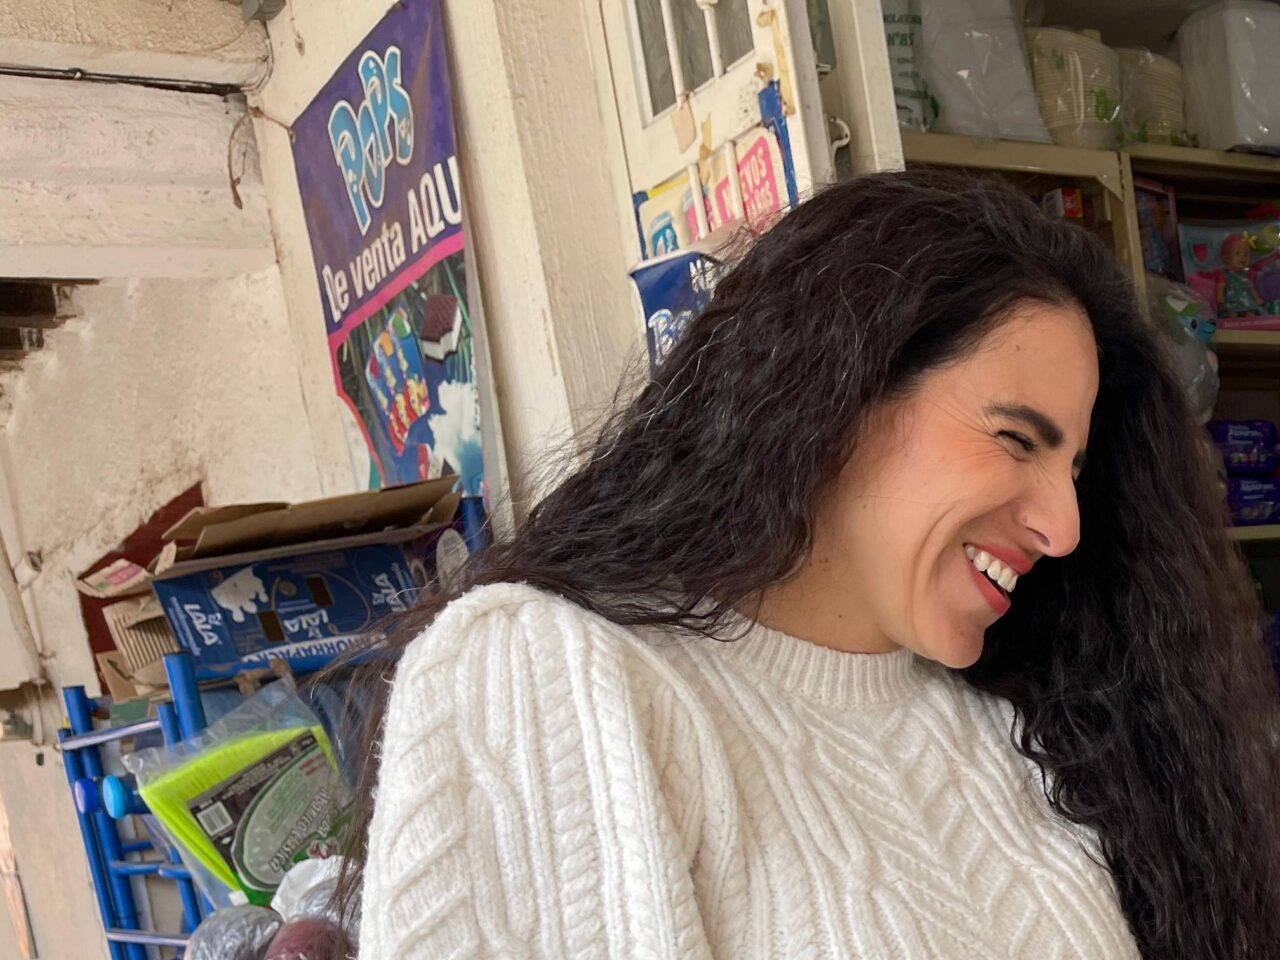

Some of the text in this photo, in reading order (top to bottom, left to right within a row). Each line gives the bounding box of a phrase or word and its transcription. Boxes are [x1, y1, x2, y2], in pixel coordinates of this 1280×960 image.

[322, 155, 463, 323] De venta AQU
